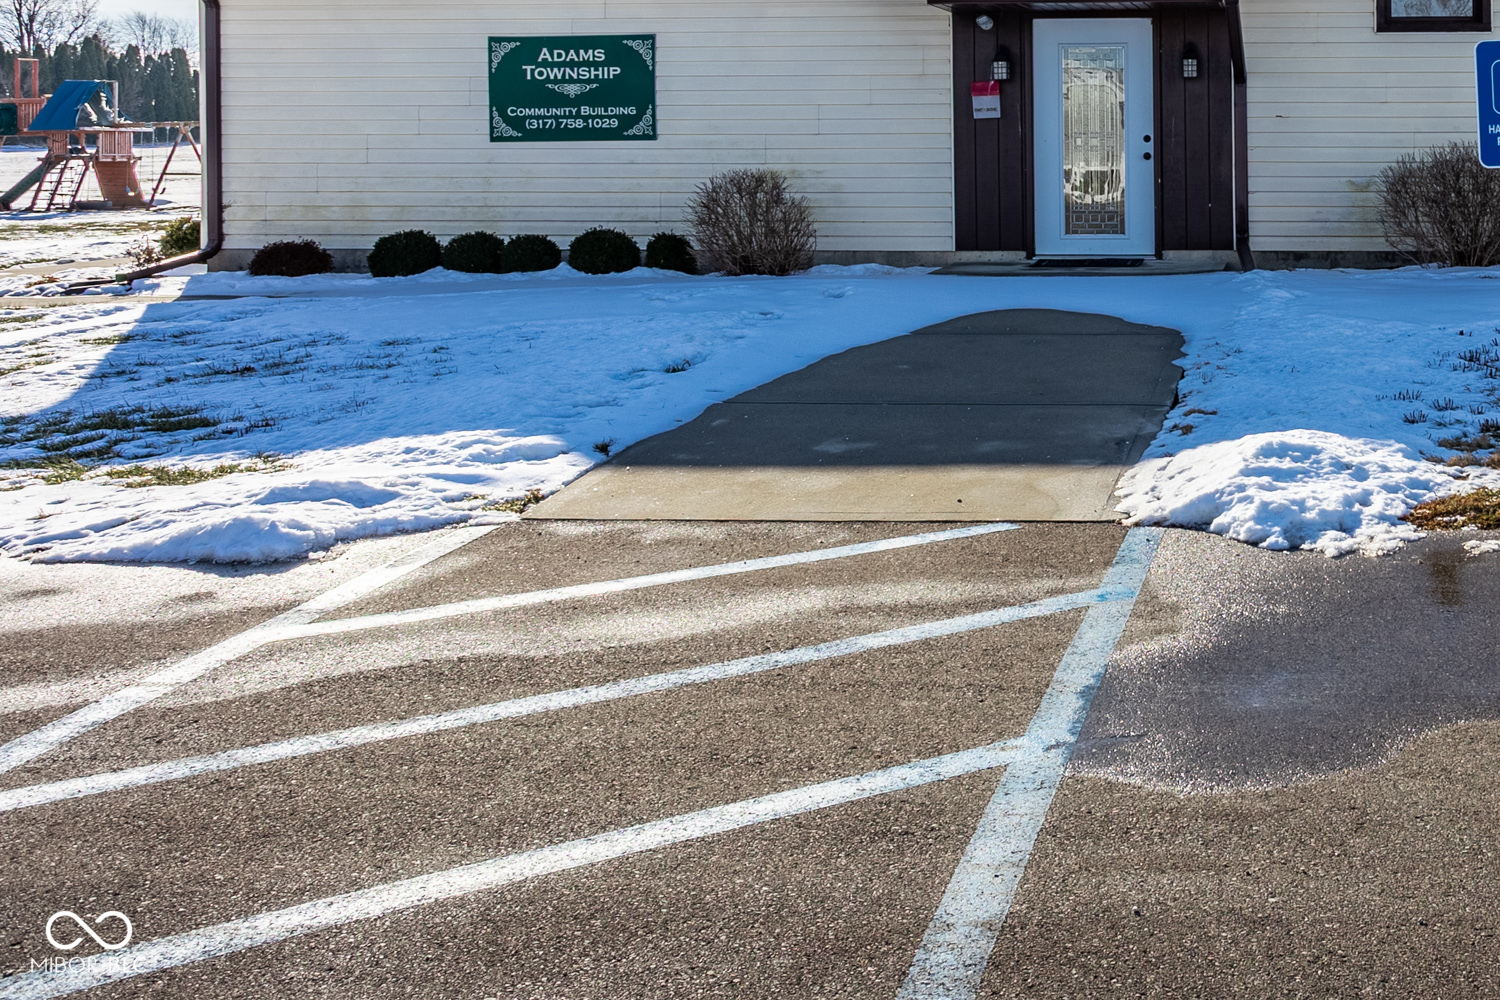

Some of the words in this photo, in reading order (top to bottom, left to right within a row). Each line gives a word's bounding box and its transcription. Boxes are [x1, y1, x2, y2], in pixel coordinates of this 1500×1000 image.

[537, 47, 606, 62] ADAMS
[522, 65, 621, 80] TOWNSHIP
[507, 106, 578, 117] COMMUNITY
[580, 106, 637, 116] BUILDING
[525, 118, 556, 130] (317)
[559, 118, 619, 129] 758-1029
